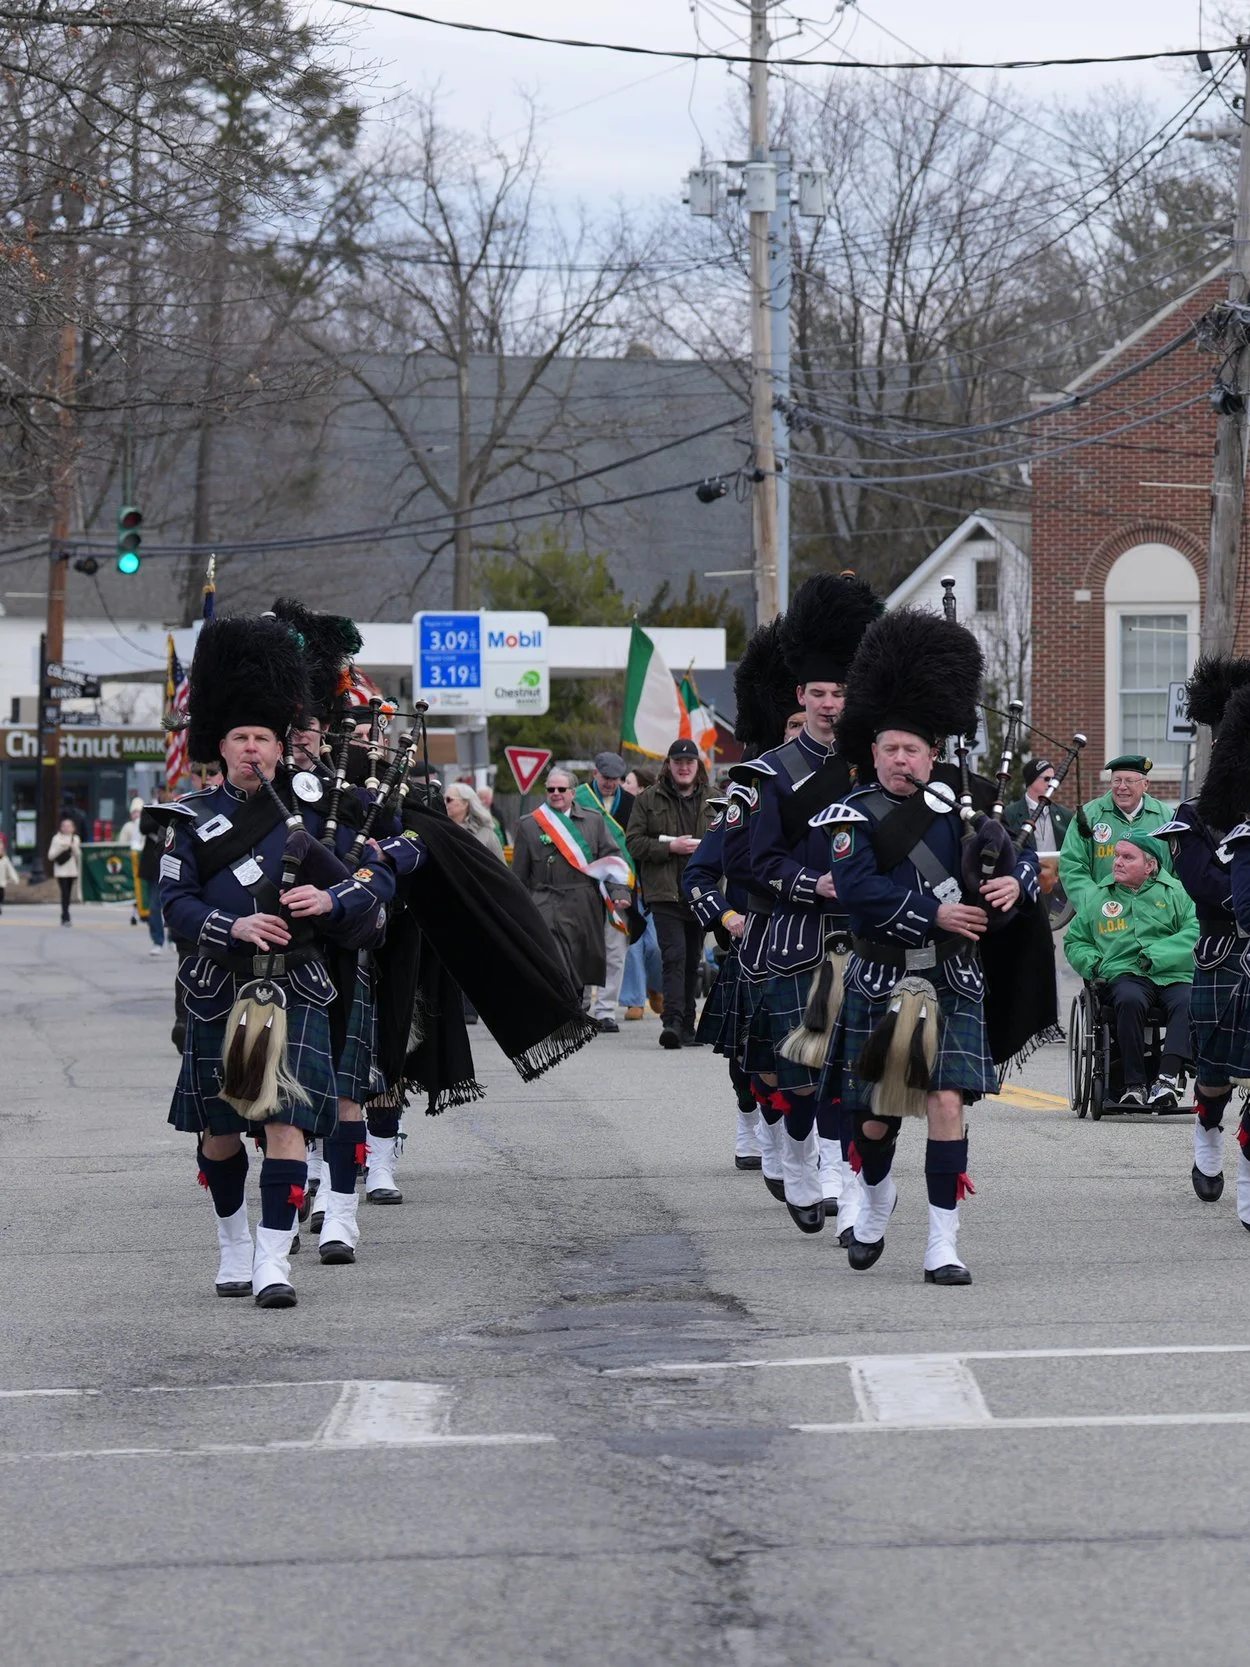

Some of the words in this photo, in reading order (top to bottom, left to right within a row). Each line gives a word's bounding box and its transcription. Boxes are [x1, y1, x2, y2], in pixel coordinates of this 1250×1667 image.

[430, 630, 469, 651] 3.09
[488, 630, 541, 648] Mobil
[430, 665, 470, 686] 3.19
[50, 685, 82, 699] KINGS
[494, 687, 541, 698] Chestnut
[6, 731, 121, 758] Chstnut
[122, 736, 166, 753] MARK
[1095, 844, 1116, 858] .O.H.
